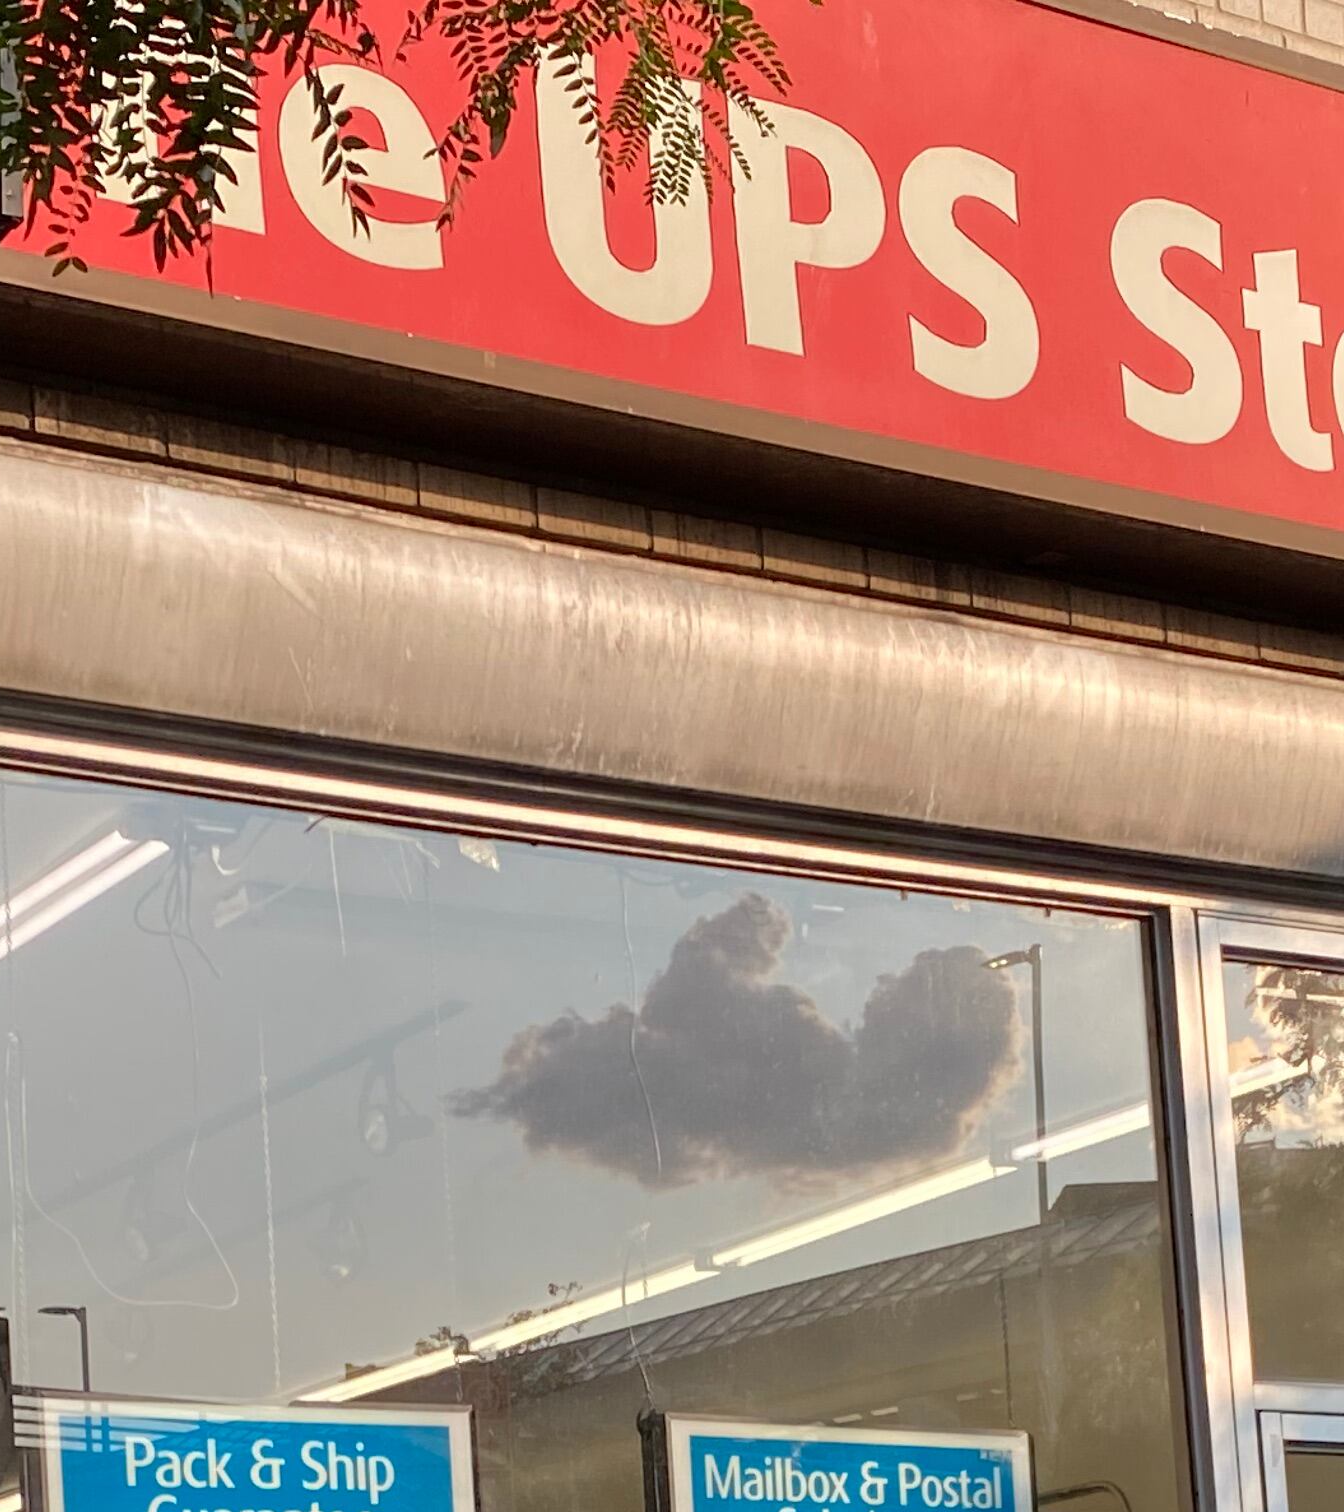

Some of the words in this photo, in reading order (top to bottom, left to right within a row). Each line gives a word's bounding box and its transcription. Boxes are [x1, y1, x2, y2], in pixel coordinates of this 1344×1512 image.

[534, 42, 1040, 400] UPS
[125, 1437, 233, 1490] Pack
[251, 1437, 285, 1490] &
[301, 1440, 396, 1506] Ship
[704, 1454, 852, 1507] Mailbox
[859, 1460, 889, 1506] &
[898, 1462, 1003, 1511] Postal
